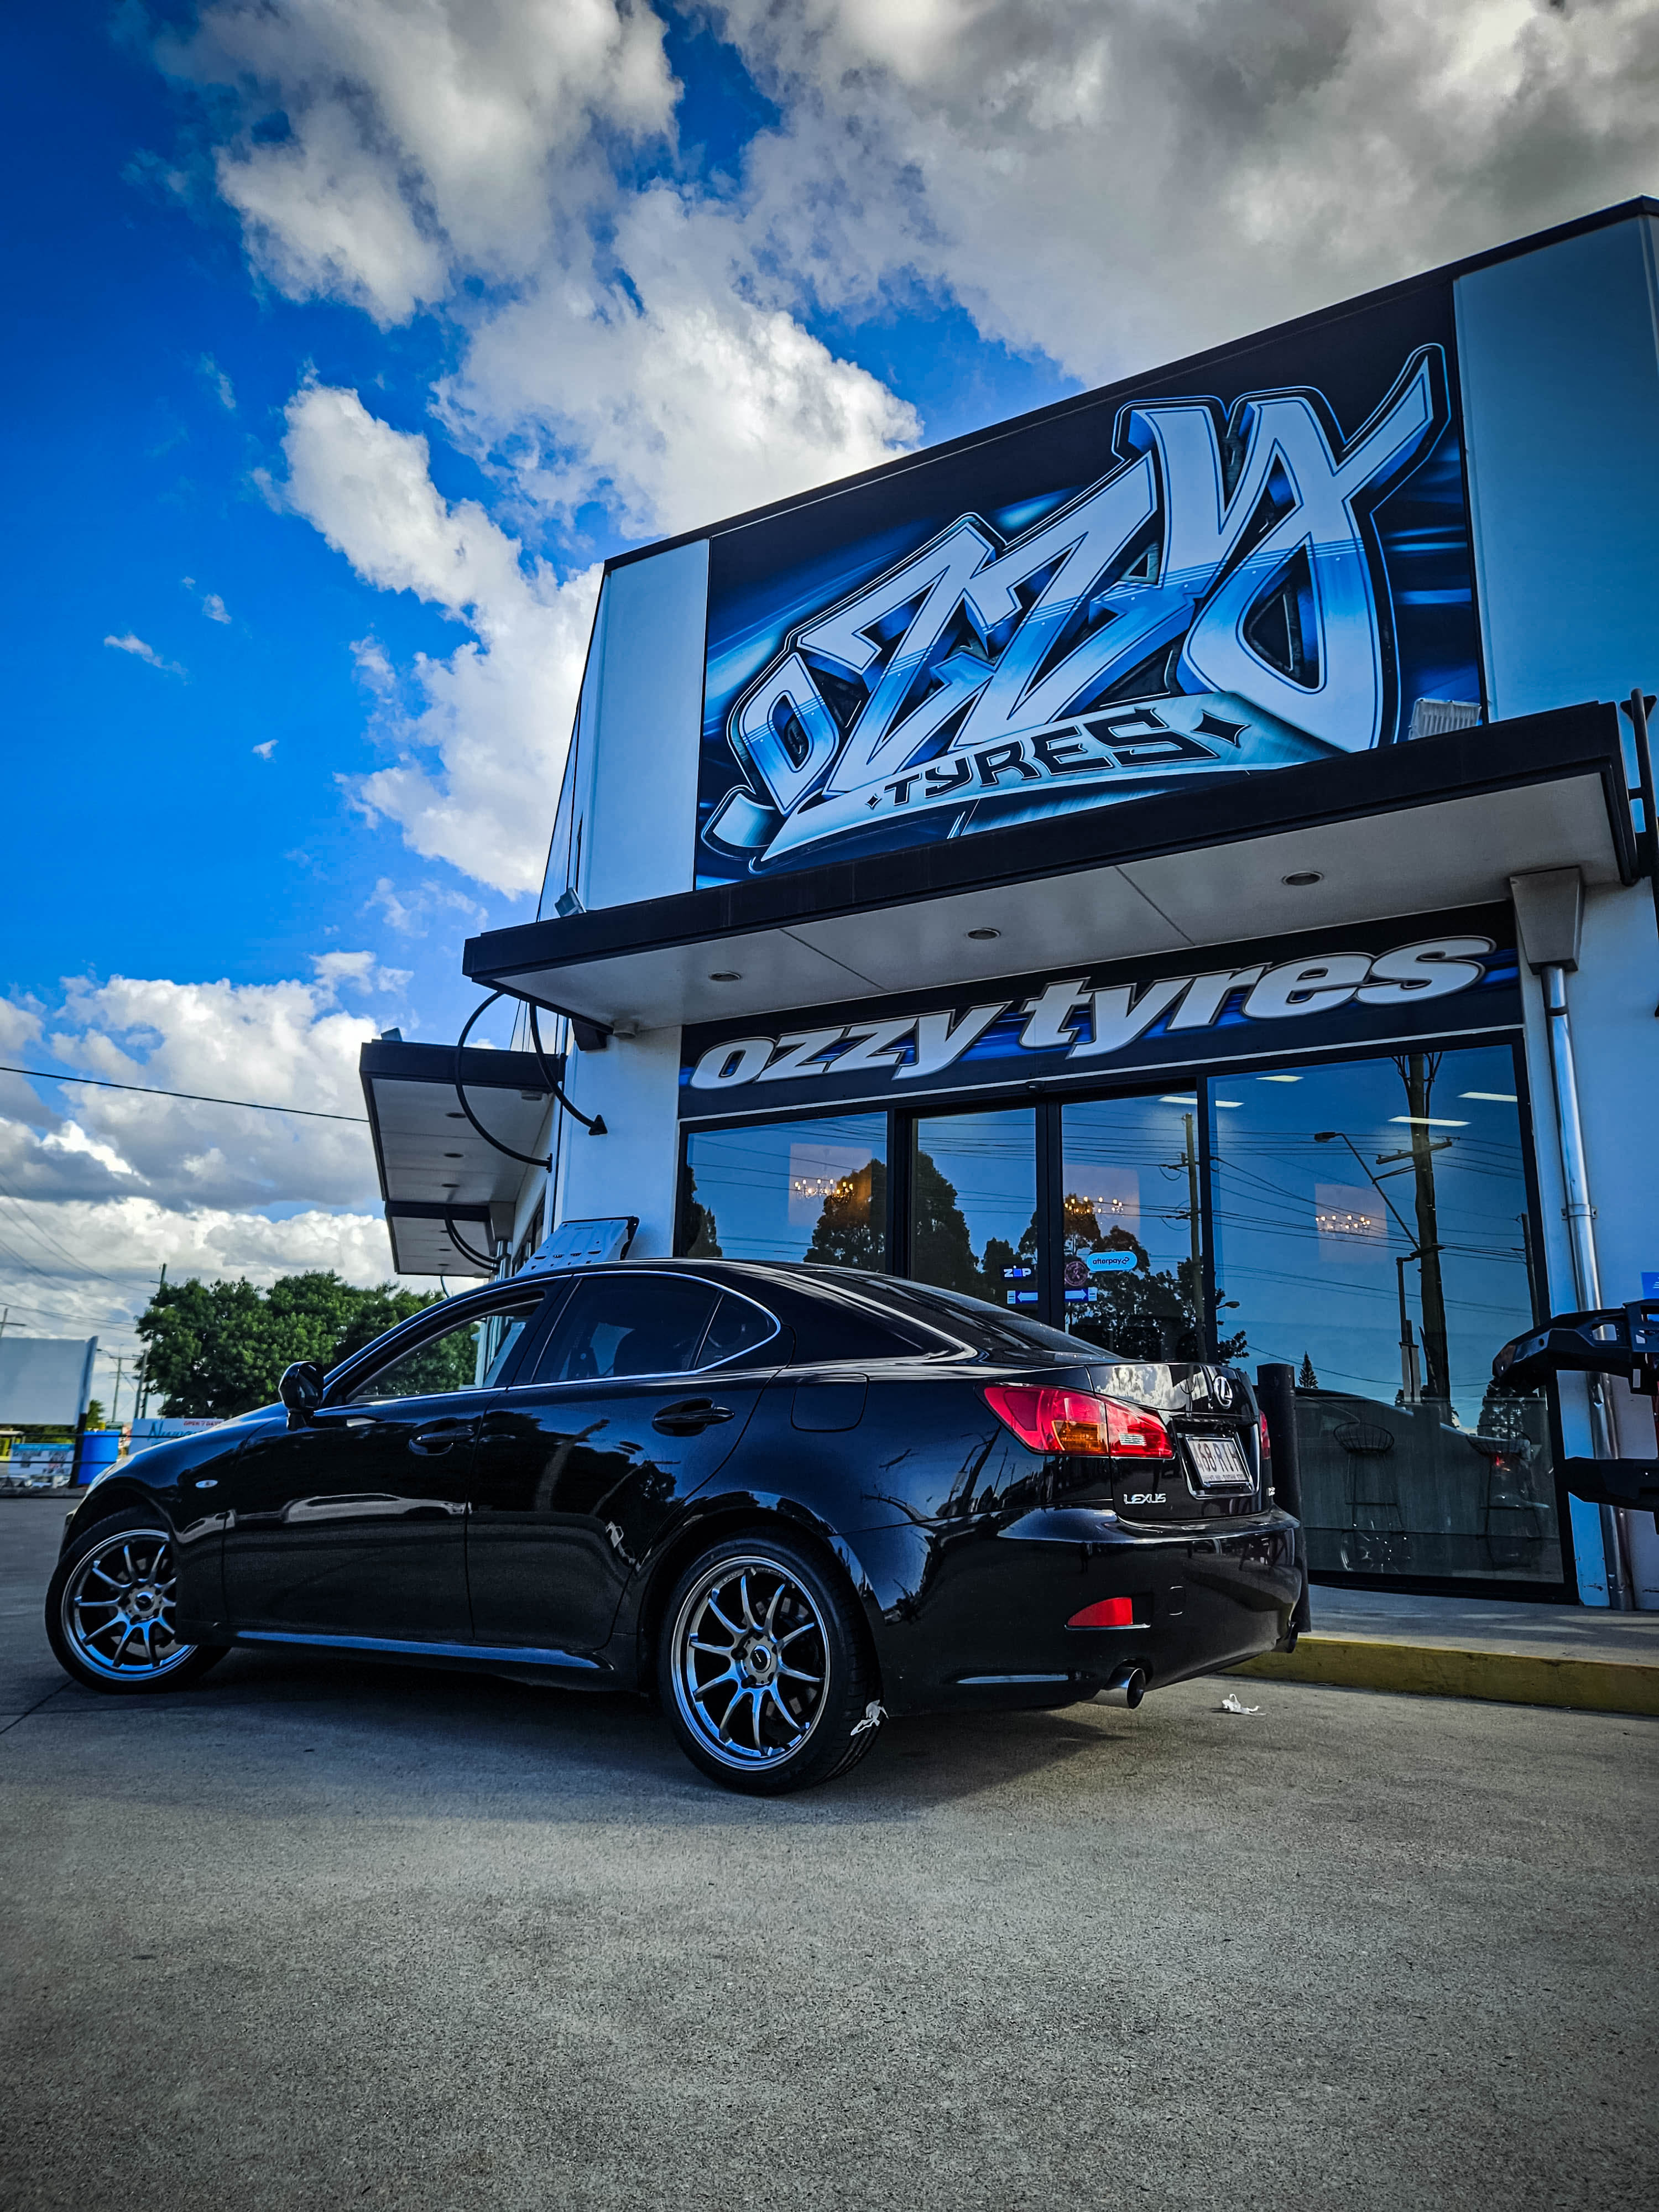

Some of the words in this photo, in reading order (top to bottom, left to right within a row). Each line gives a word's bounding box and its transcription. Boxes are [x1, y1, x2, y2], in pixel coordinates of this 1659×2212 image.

[883, 706, 1219, 805] TYRES
[689, 1000, 1011, 1090] ozzy
[1018, 936, 1496, 1059] tyres
[1092, 1256, 1121, 1265] afterpay
[1123, 1493, 1167, 1504] LEXUS
